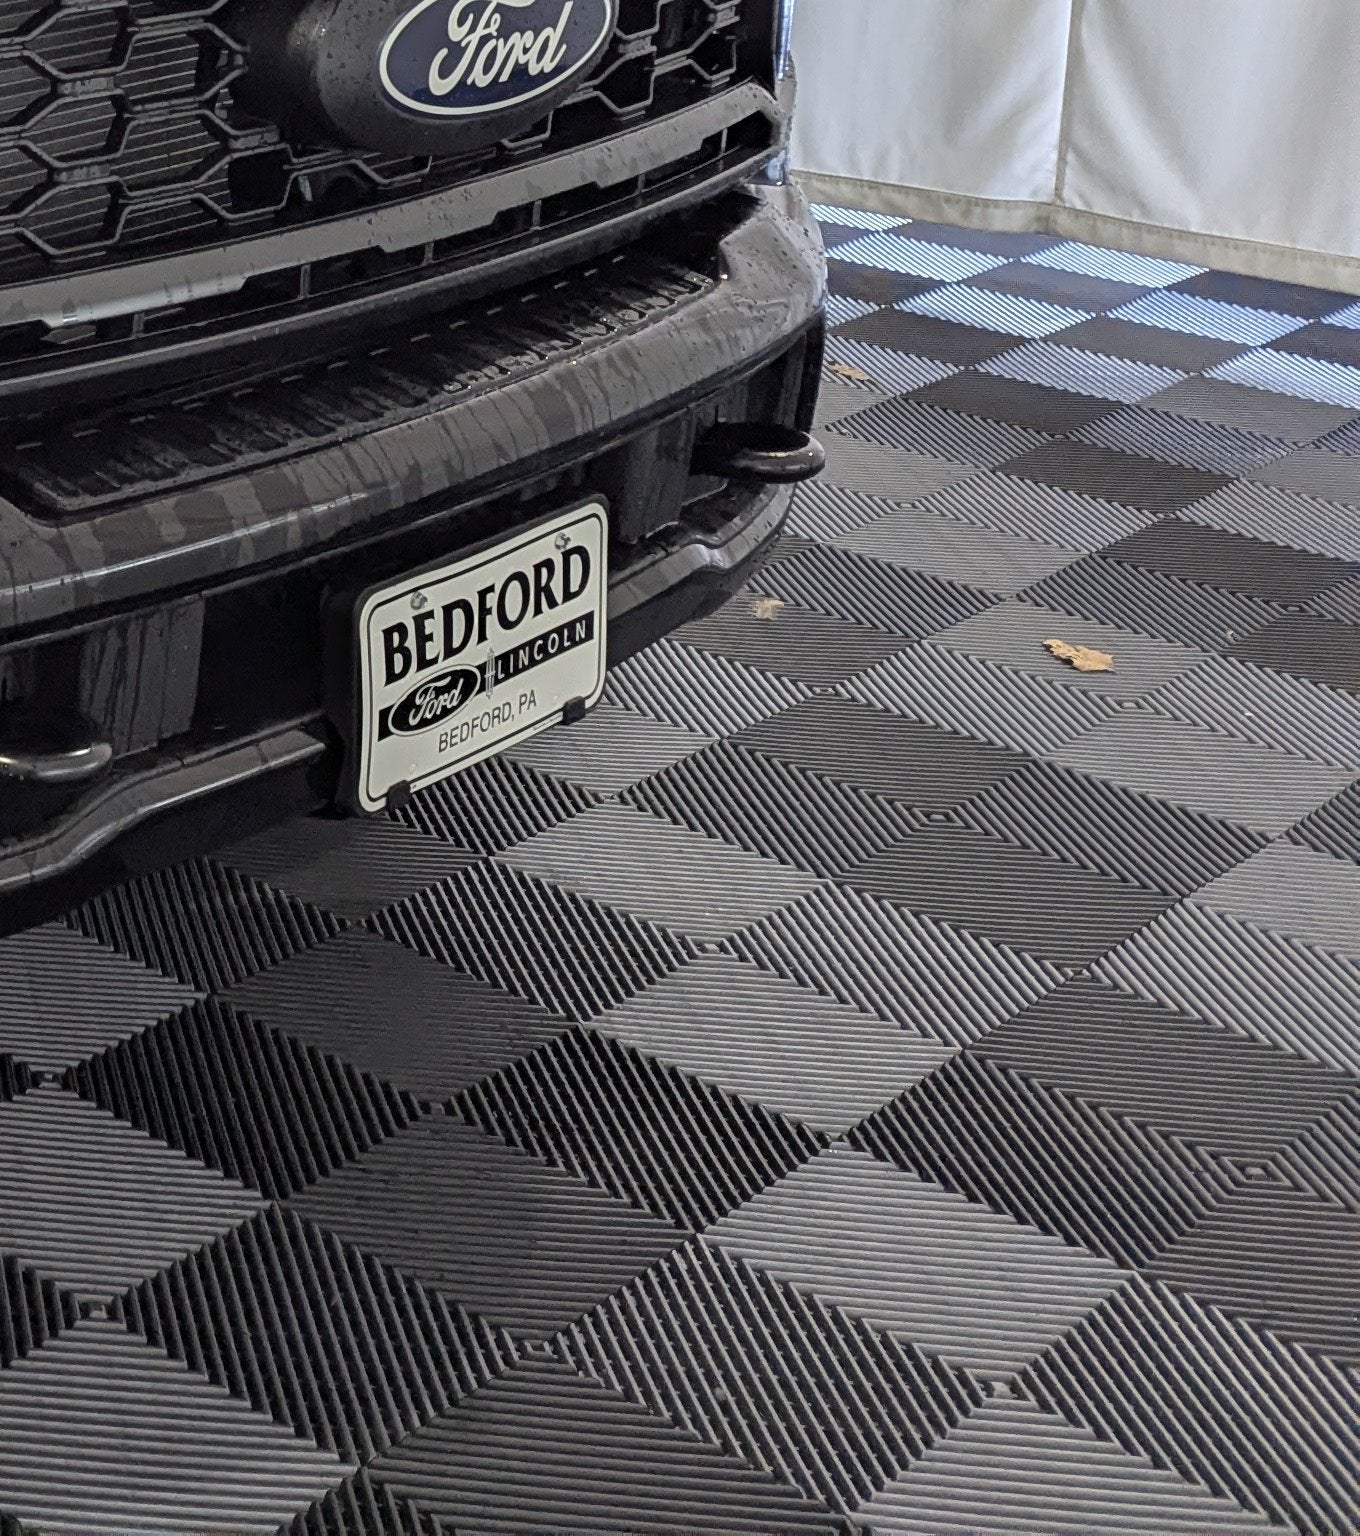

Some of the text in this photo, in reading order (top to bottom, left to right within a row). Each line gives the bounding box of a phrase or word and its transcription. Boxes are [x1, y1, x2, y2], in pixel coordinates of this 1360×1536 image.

[381, 544, 591, 688] BEDFORD
[497, 619, 587, 681] LINCOLN
[408, 673, 463, 727] Ford
[438, 702, 515, 753] BEDFORD,
[519, 689, 538, 721] PA
